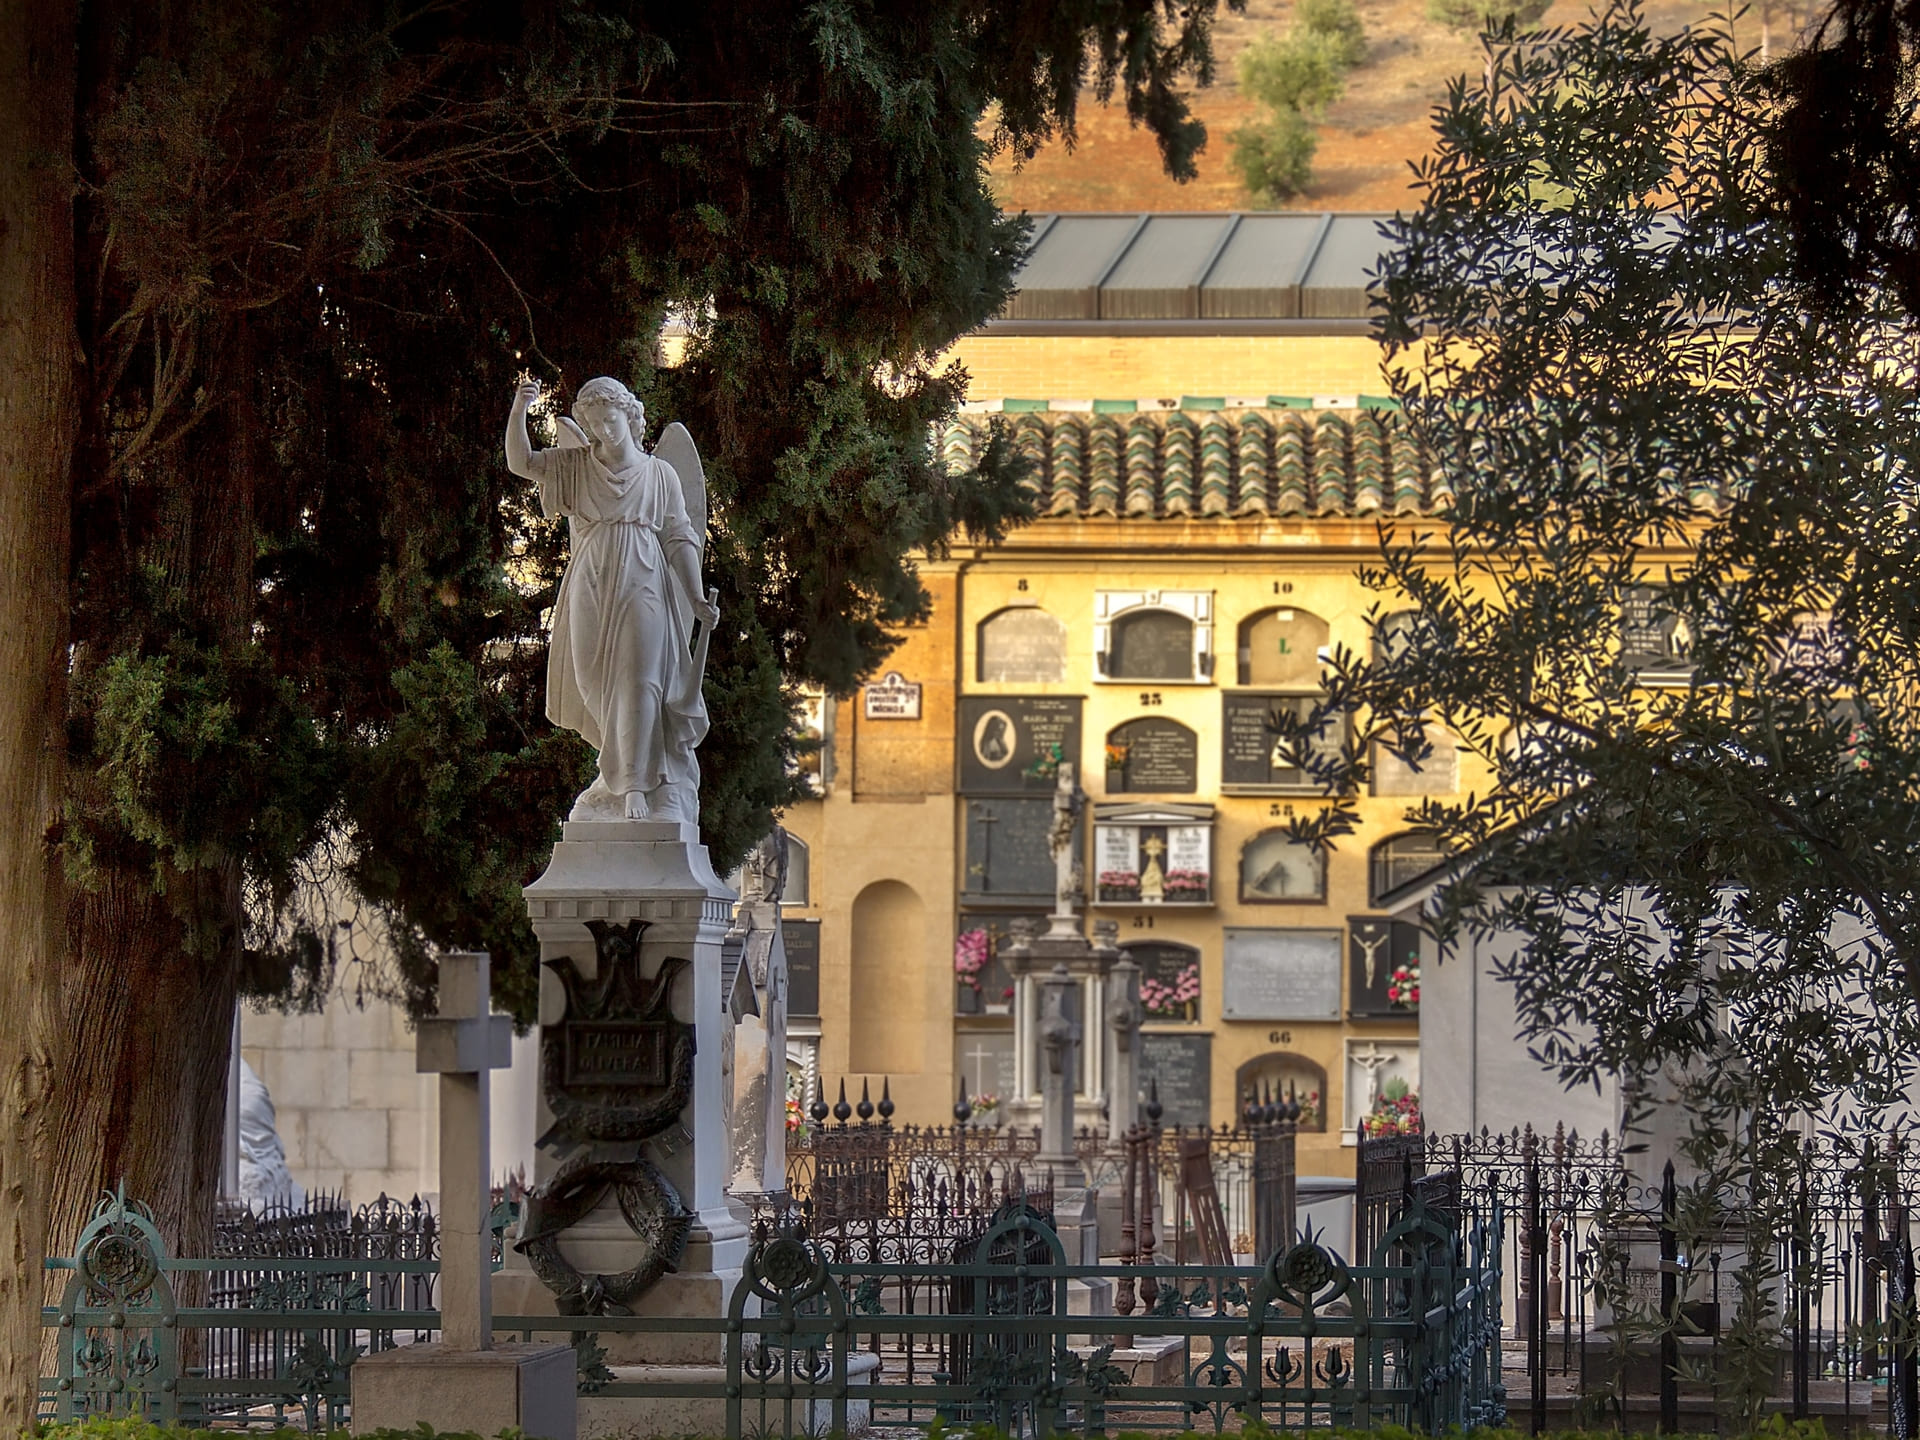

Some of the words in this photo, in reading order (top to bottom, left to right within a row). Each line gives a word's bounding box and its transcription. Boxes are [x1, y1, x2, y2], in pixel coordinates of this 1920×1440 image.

[1018, 579, 1029, 592] 8
[1273, 581, 1293, 594] 10
[1269, 1031, 1291, 1044] 66
